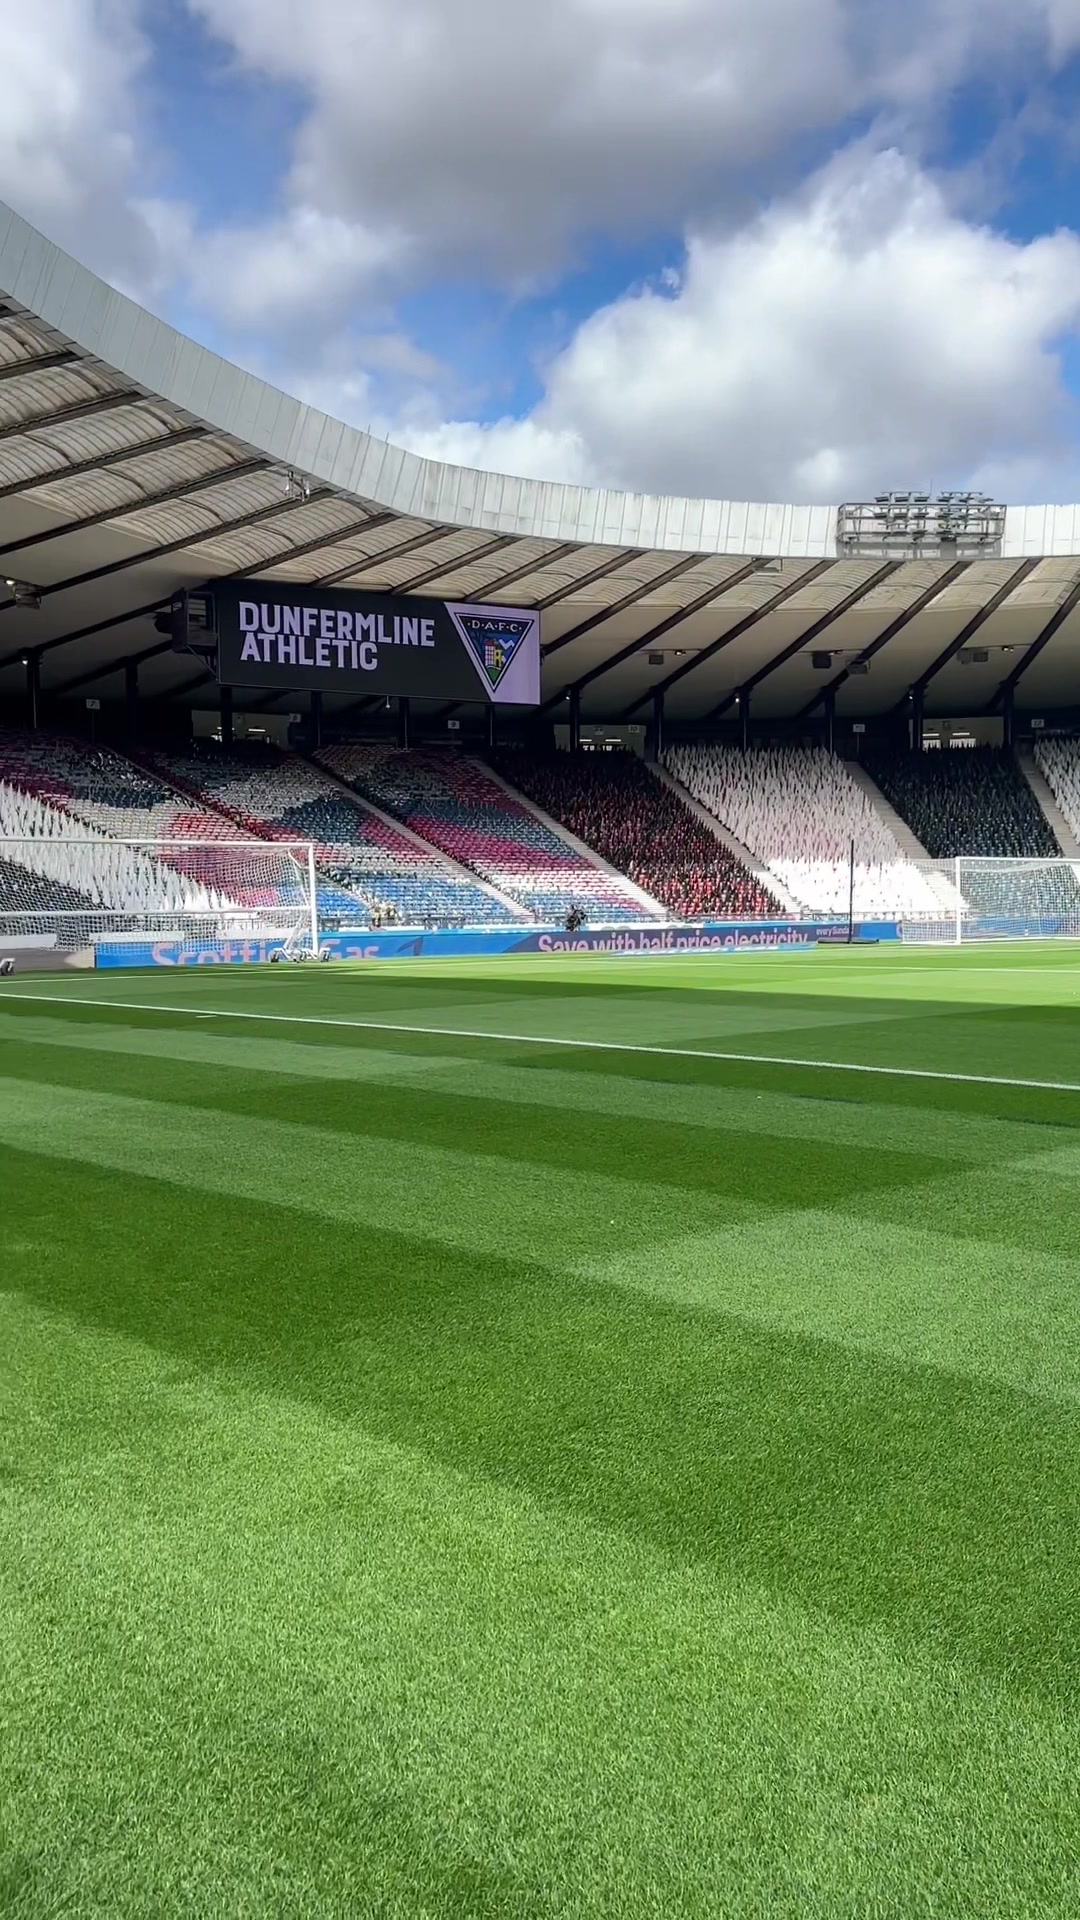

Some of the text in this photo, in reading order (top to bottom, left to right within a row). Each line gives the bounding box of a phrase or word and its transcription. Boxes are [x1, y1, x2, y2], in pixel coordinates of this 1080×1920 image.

[239, 601, 435, 647] DUNFERMLINE
[240, 631, 378, 671] ATHLETIC
[538, 935, 590, 952] Save
[592, 932, 635, 951] with
[640, 931, 674, 949] half
[724, 926, 808, 946] electricity
